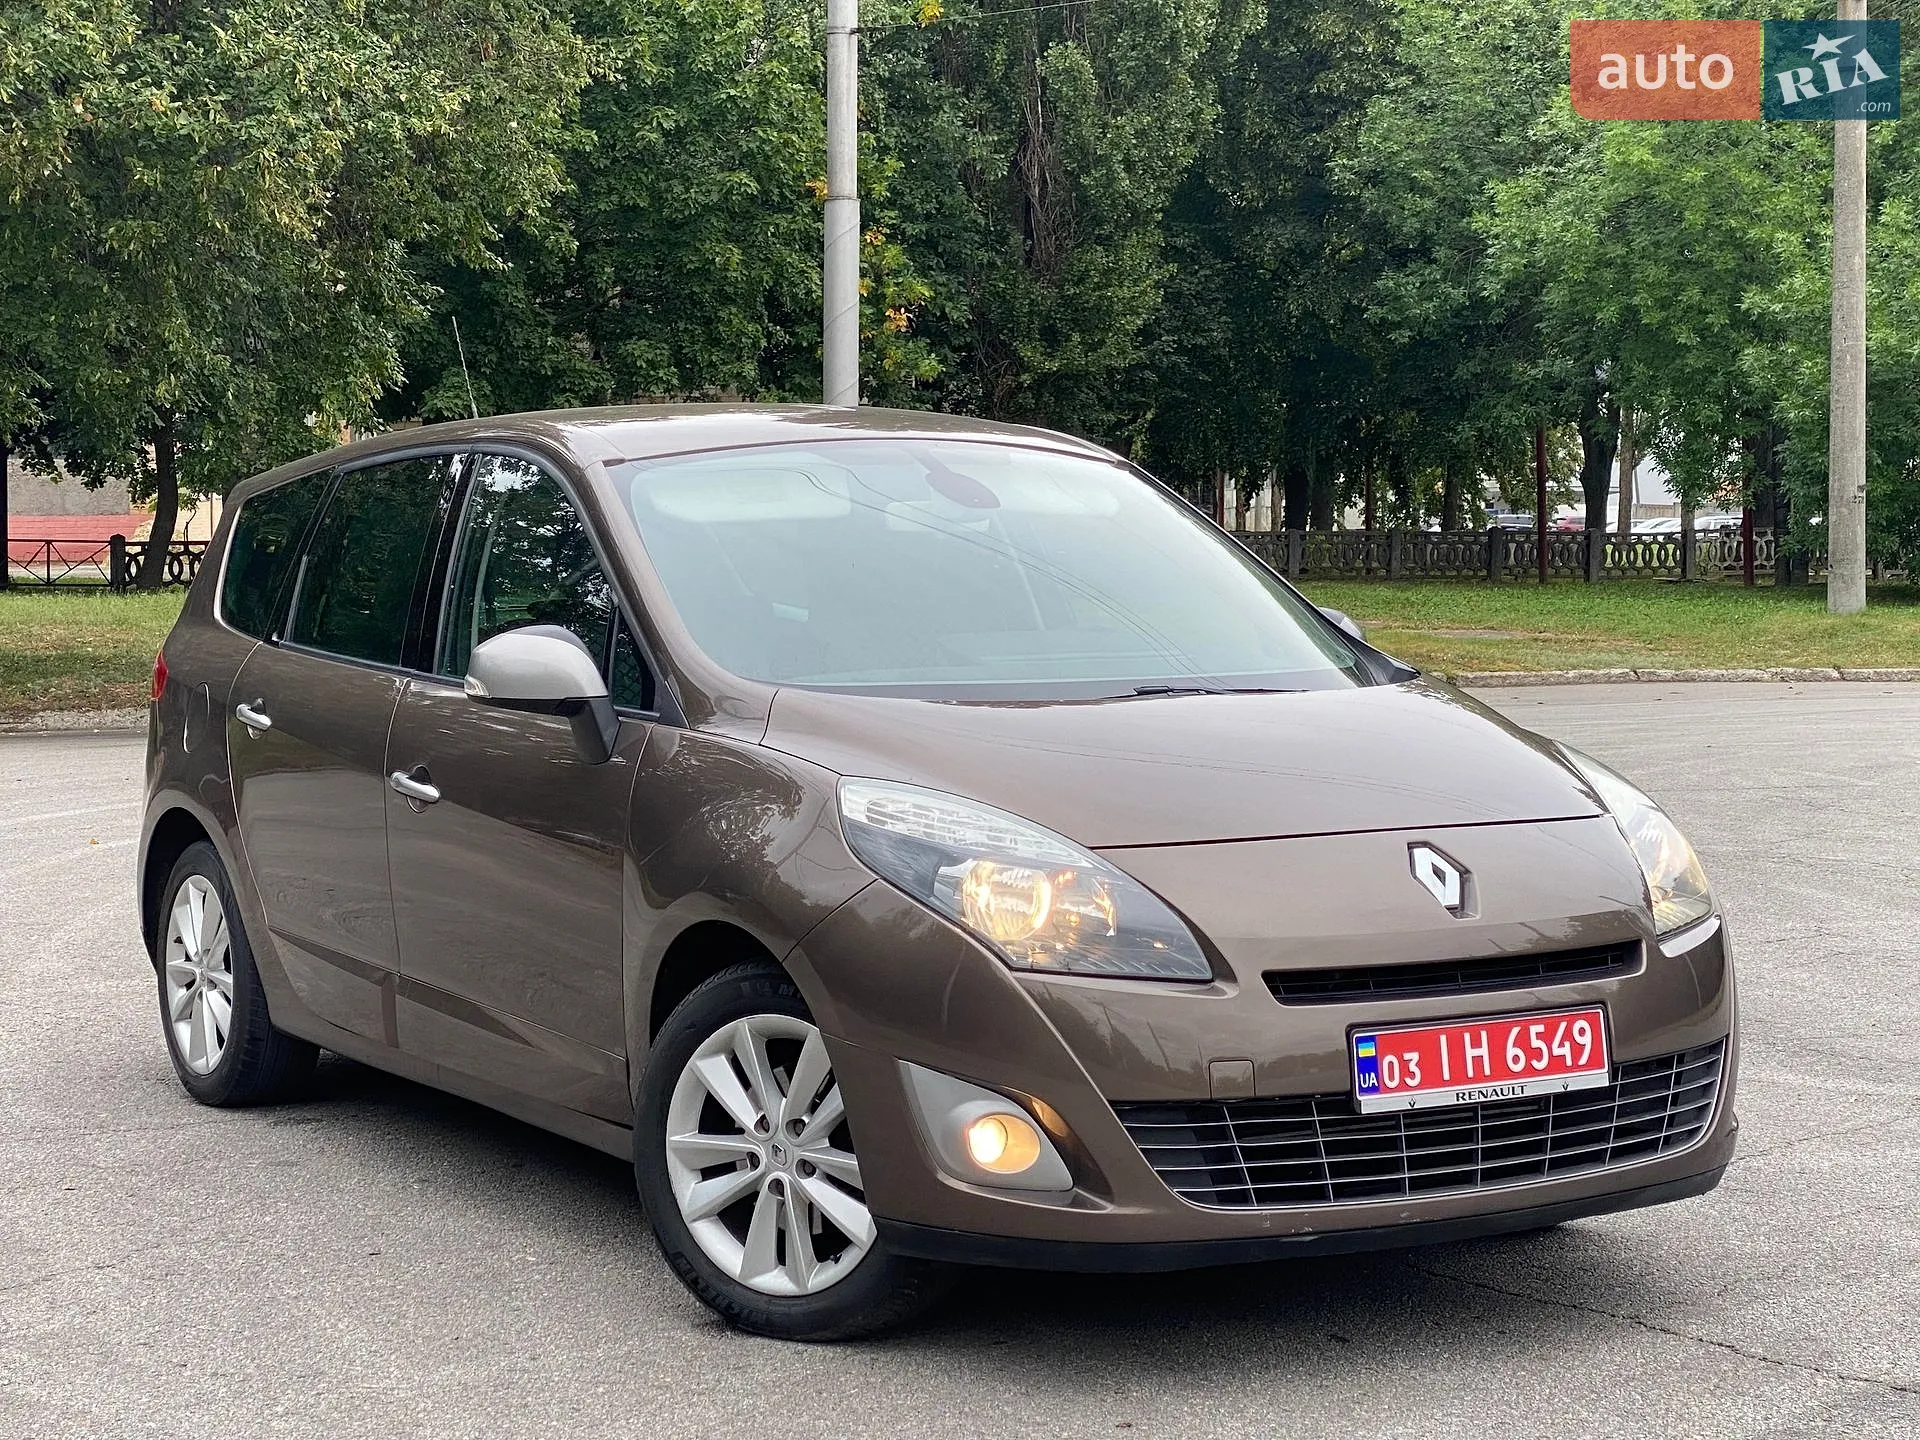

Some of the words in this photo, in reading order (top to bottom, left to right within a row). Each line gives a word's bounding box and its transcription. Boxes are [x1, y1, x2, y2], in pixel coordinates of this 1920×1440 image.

[1382, 1051, 1422, 1089] 03
[1506, 1019, 1593, 1073] 6549
[1360, 1073, 1378, 1089] UA
[1455, 1084, 1528, 1102] RENAULT
